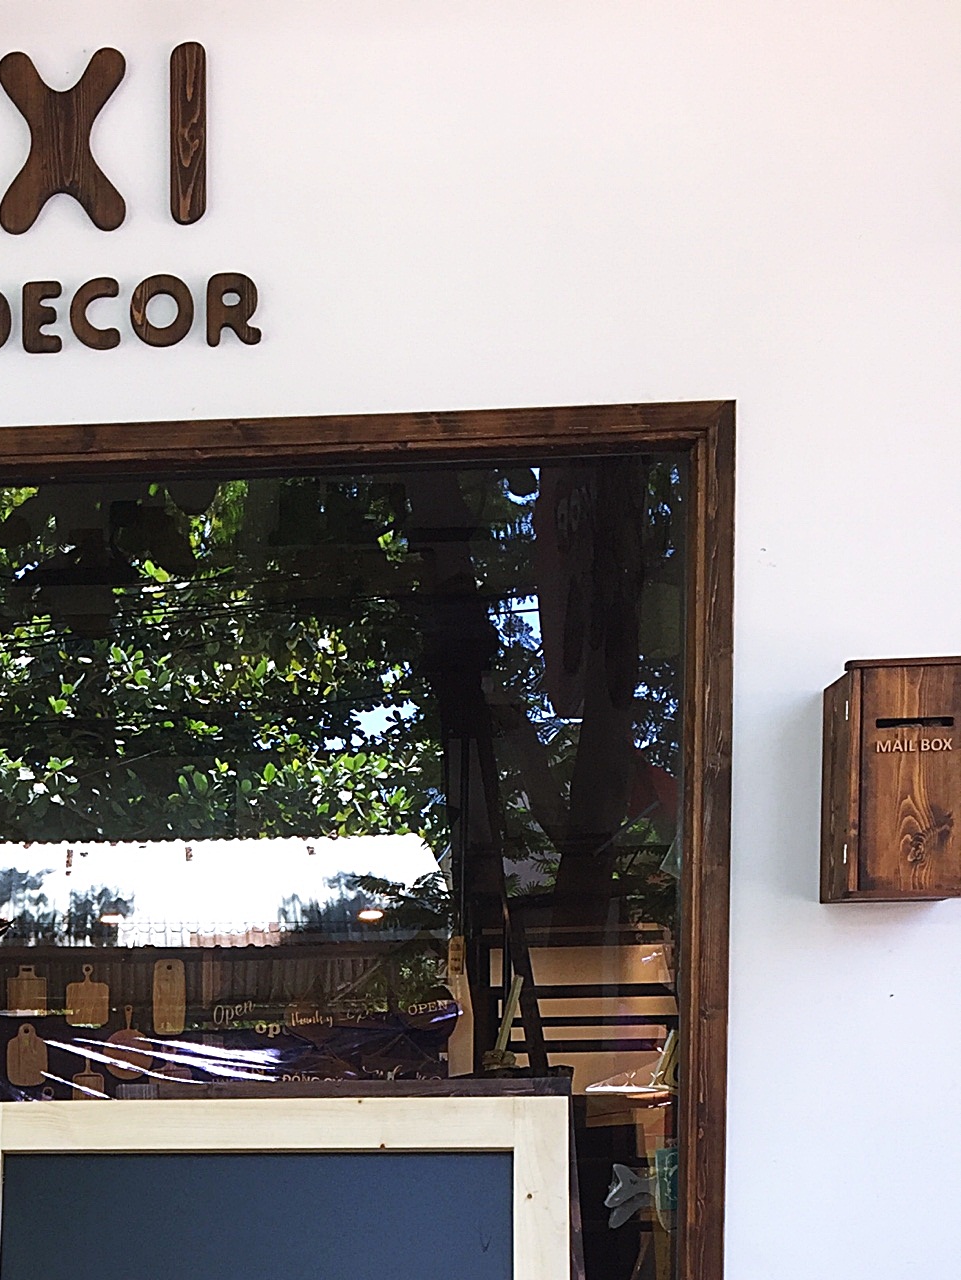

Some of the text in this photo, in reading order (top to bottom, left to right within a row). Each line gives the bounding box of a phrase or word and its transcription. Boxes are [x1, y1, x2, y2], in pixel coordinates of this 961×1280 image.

[876, 738, 953, 753] MAIL BOX
[213, 1000, 256, 1025] Open
[408, 1000, 449, 1016] OPEN
